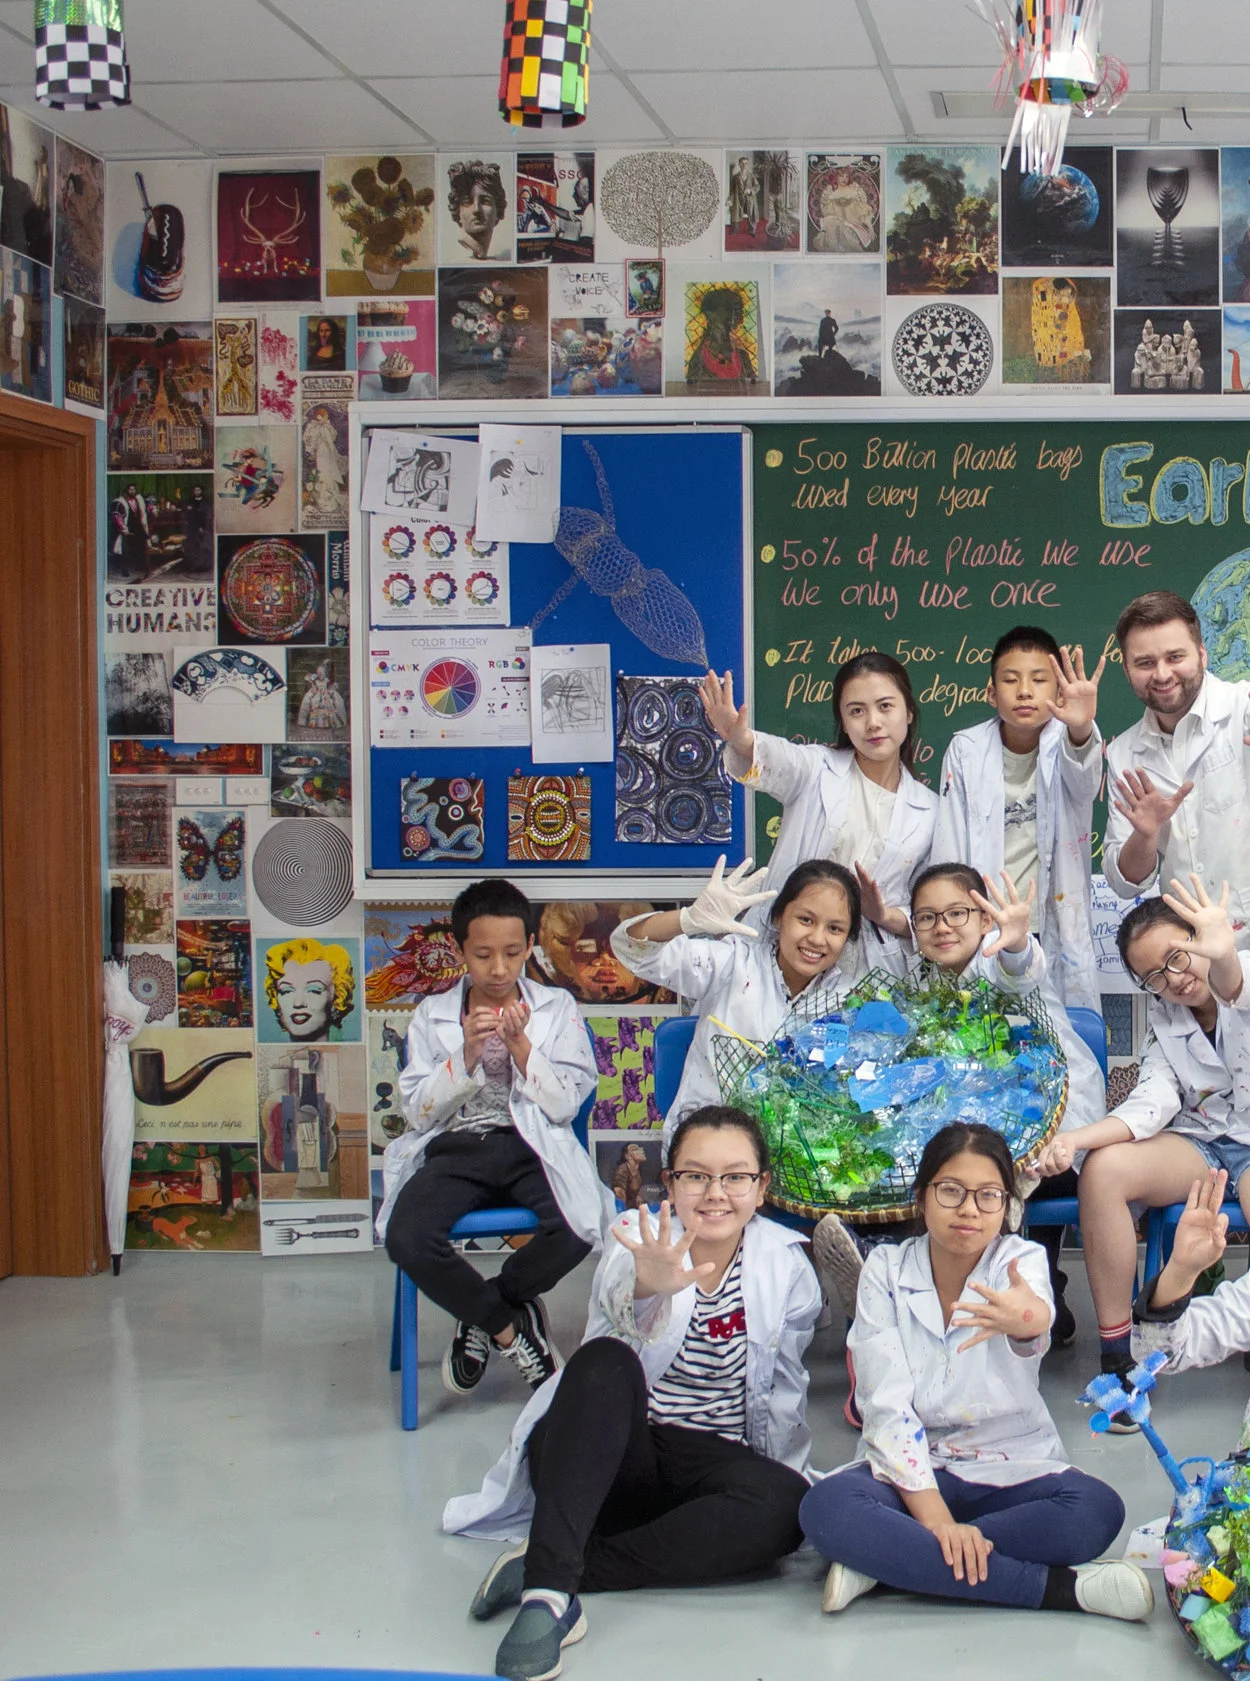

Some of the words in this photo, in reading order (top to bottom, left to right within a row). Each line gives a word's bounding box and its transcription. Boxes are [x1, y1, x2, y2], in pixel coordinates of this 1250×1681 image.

[568, 273, 609, 283] CREATE
[575, 286, 602, 295] VOICE
[68, 379, 100, 402] GOTHIC
[793, 438, 847, 475] 500
[862, 437, 936, 471] Billion
[1036, 441, 1083, 482] bags
[867, 484, 919, 518] every
[936, 484, 993, 516] year
[330, 542, 342, 580] Morris
[781, 536, 842, 571] 50%
[857, 533, 879, 573] of
[890, 536, 930, 567] the
[105, 587, 216, 608] CREATIVE
[841, 580, 899, 620] only
[106, 611, 217, 634] HUMANS
[411, 638, 447, 647] COLOR
[449, 637, 489, 647] THEORY
[390, 663, 420, 673] CMYK
[488, 660, 509, 669] RGB
